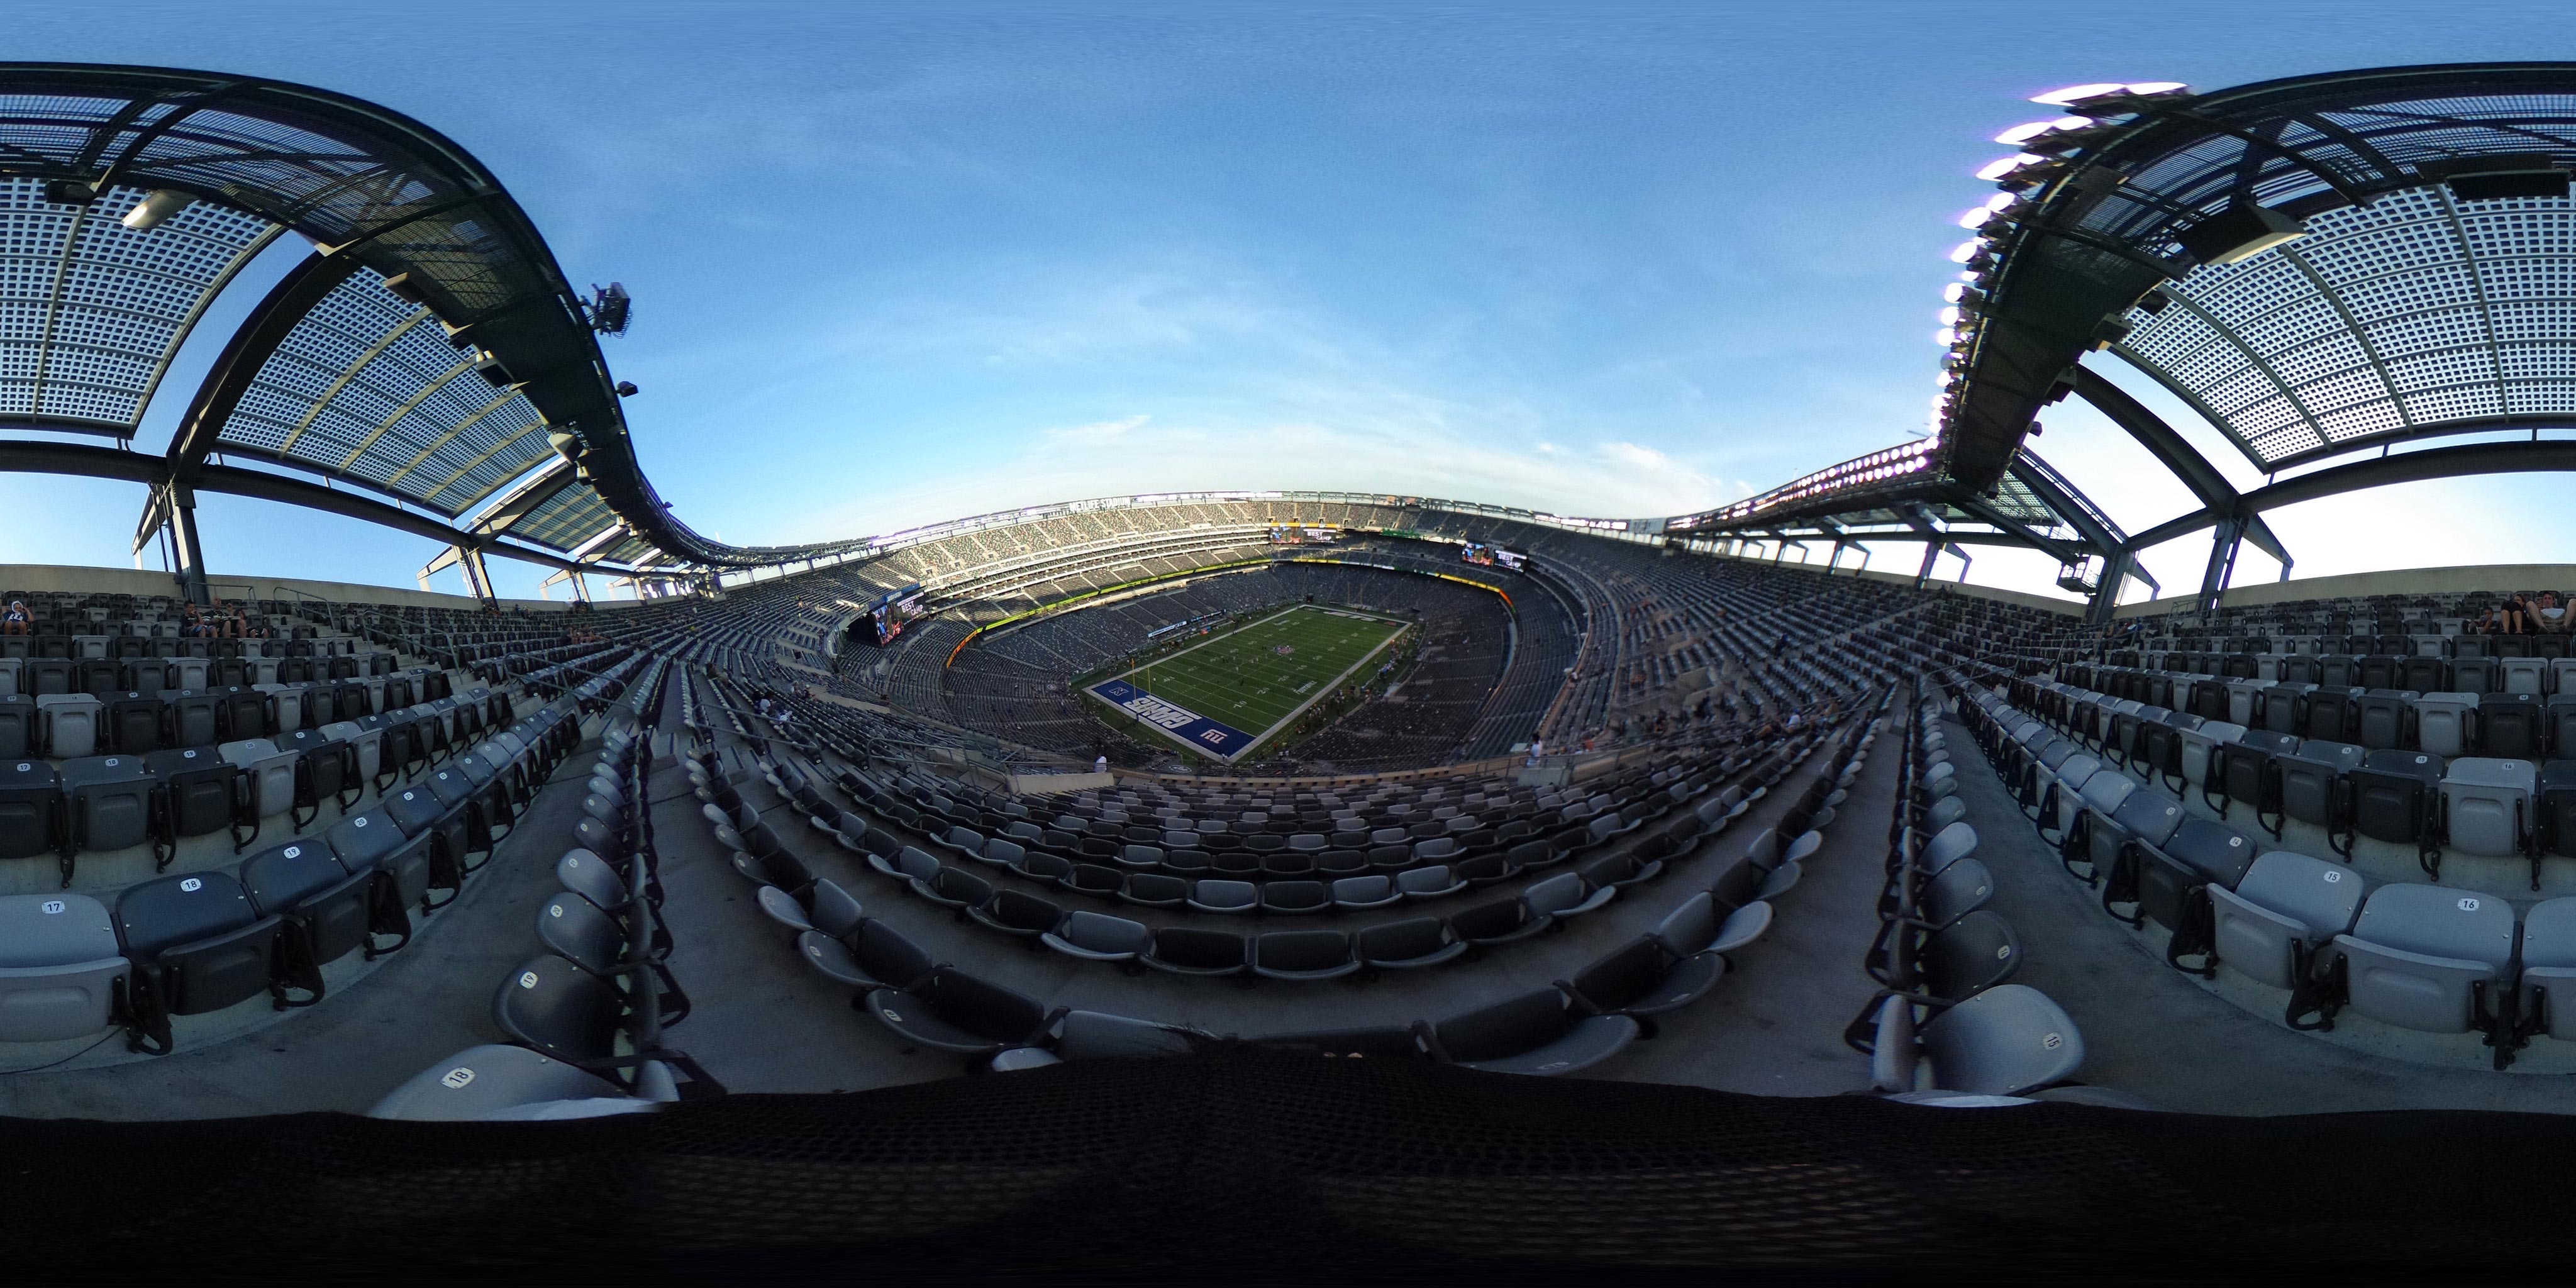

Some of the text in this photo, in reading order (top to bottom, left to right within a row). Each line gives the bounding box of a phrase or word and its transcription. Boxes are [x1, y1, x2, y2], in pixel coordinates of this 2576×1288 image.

[1069, 496, 1130, 513] METLIFE STADIUM
[901, 601, 914, 613] BEST
[910, 604, 923, 616] CAMP
[1233, 700, 1247, 708] 10
[1123, 697, 1195, 728] GIANTS
[2328, 873, 2337, 881] 15
[186, 880, 197, 889] 18
[48, 903, 60, 911] 17
[553, 907, 560, 915] 20
[1999, 948, 2008, 957] 14
[524, 975, 535, 984] 19
[2046, 1036, 2060, 1047] 15
[449, 1071, 469, 1083] 18
